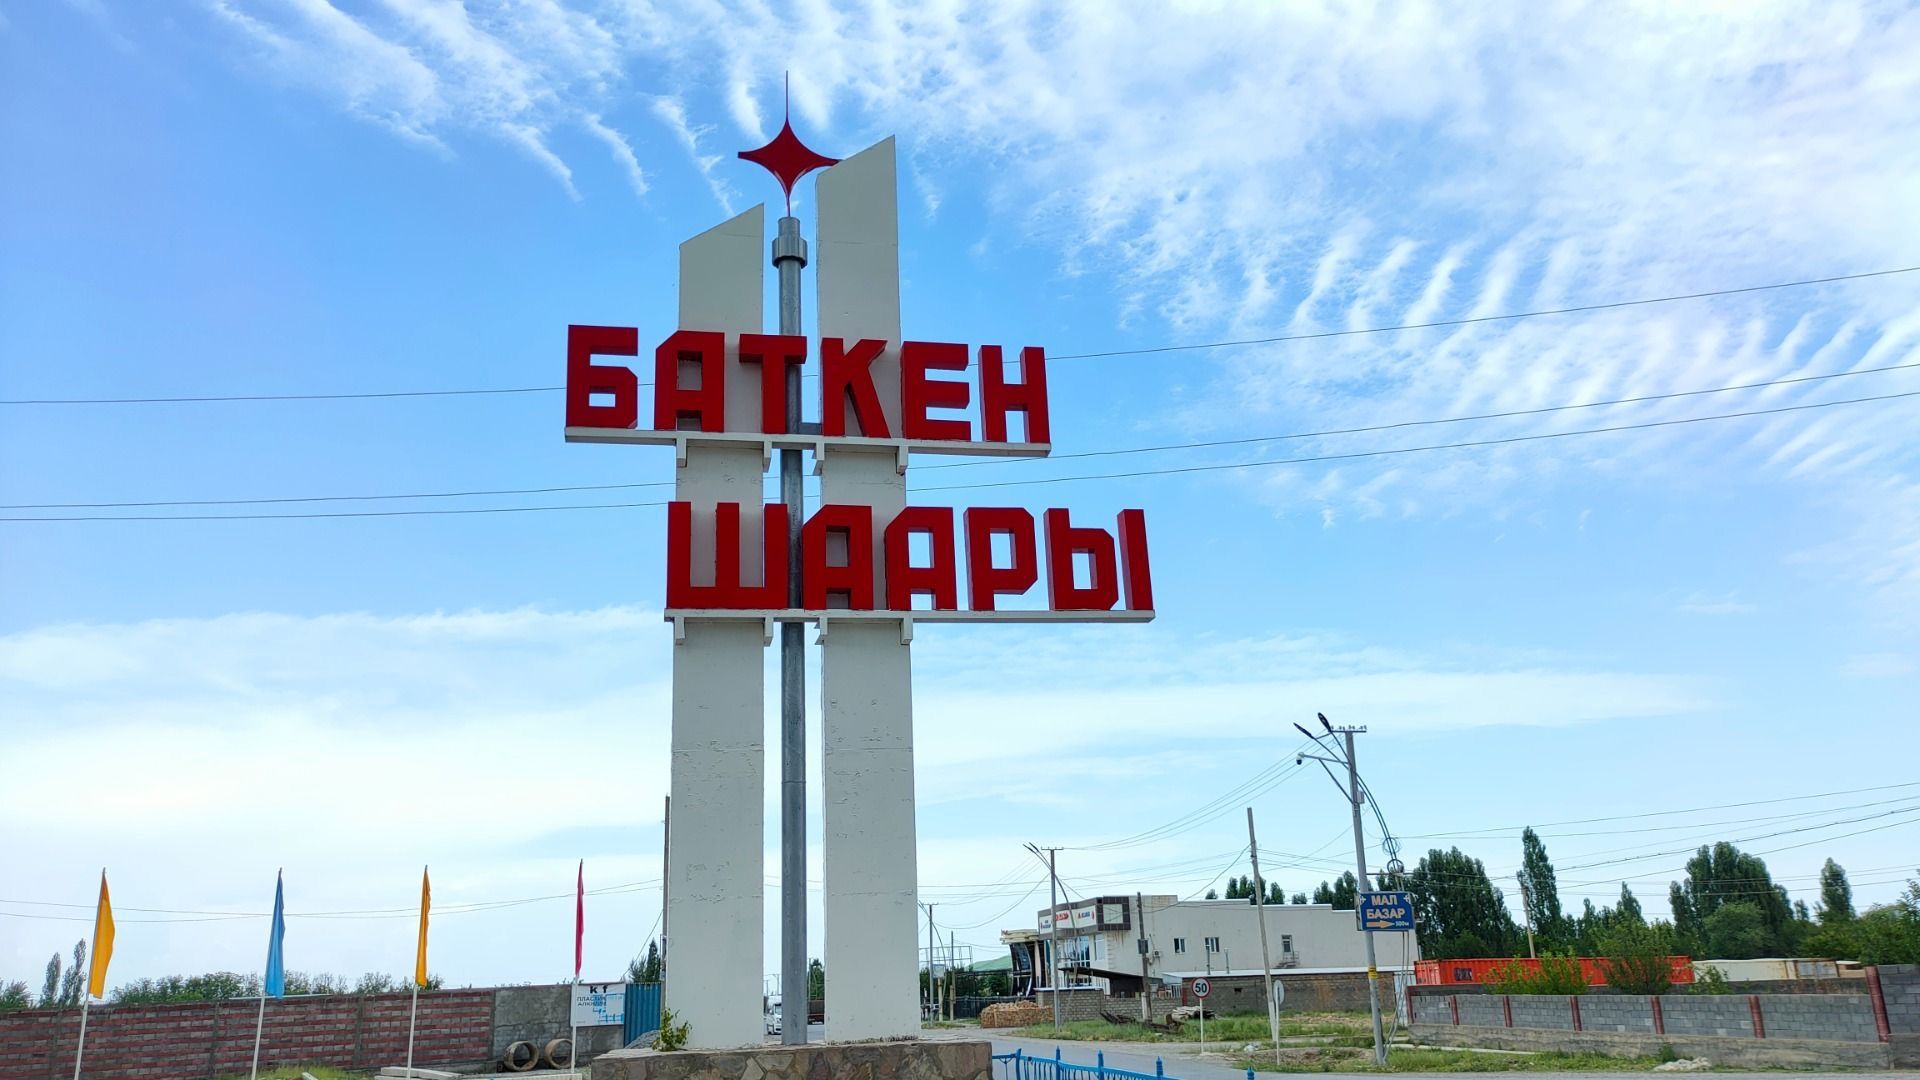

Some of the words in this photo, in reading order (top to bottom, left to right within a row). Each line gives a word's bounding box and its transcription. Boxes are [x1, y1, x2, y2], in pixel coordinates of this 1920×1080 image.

[566, 324, 1051, 444] БАТКЕН
[667, 501, 1154, 611] ШААРЫ
[1371, 895, 1398, 906] МАЛ
[1366, 908, 1406, 919] БАЗАР
[1195, 982, 1208, 993] 50
